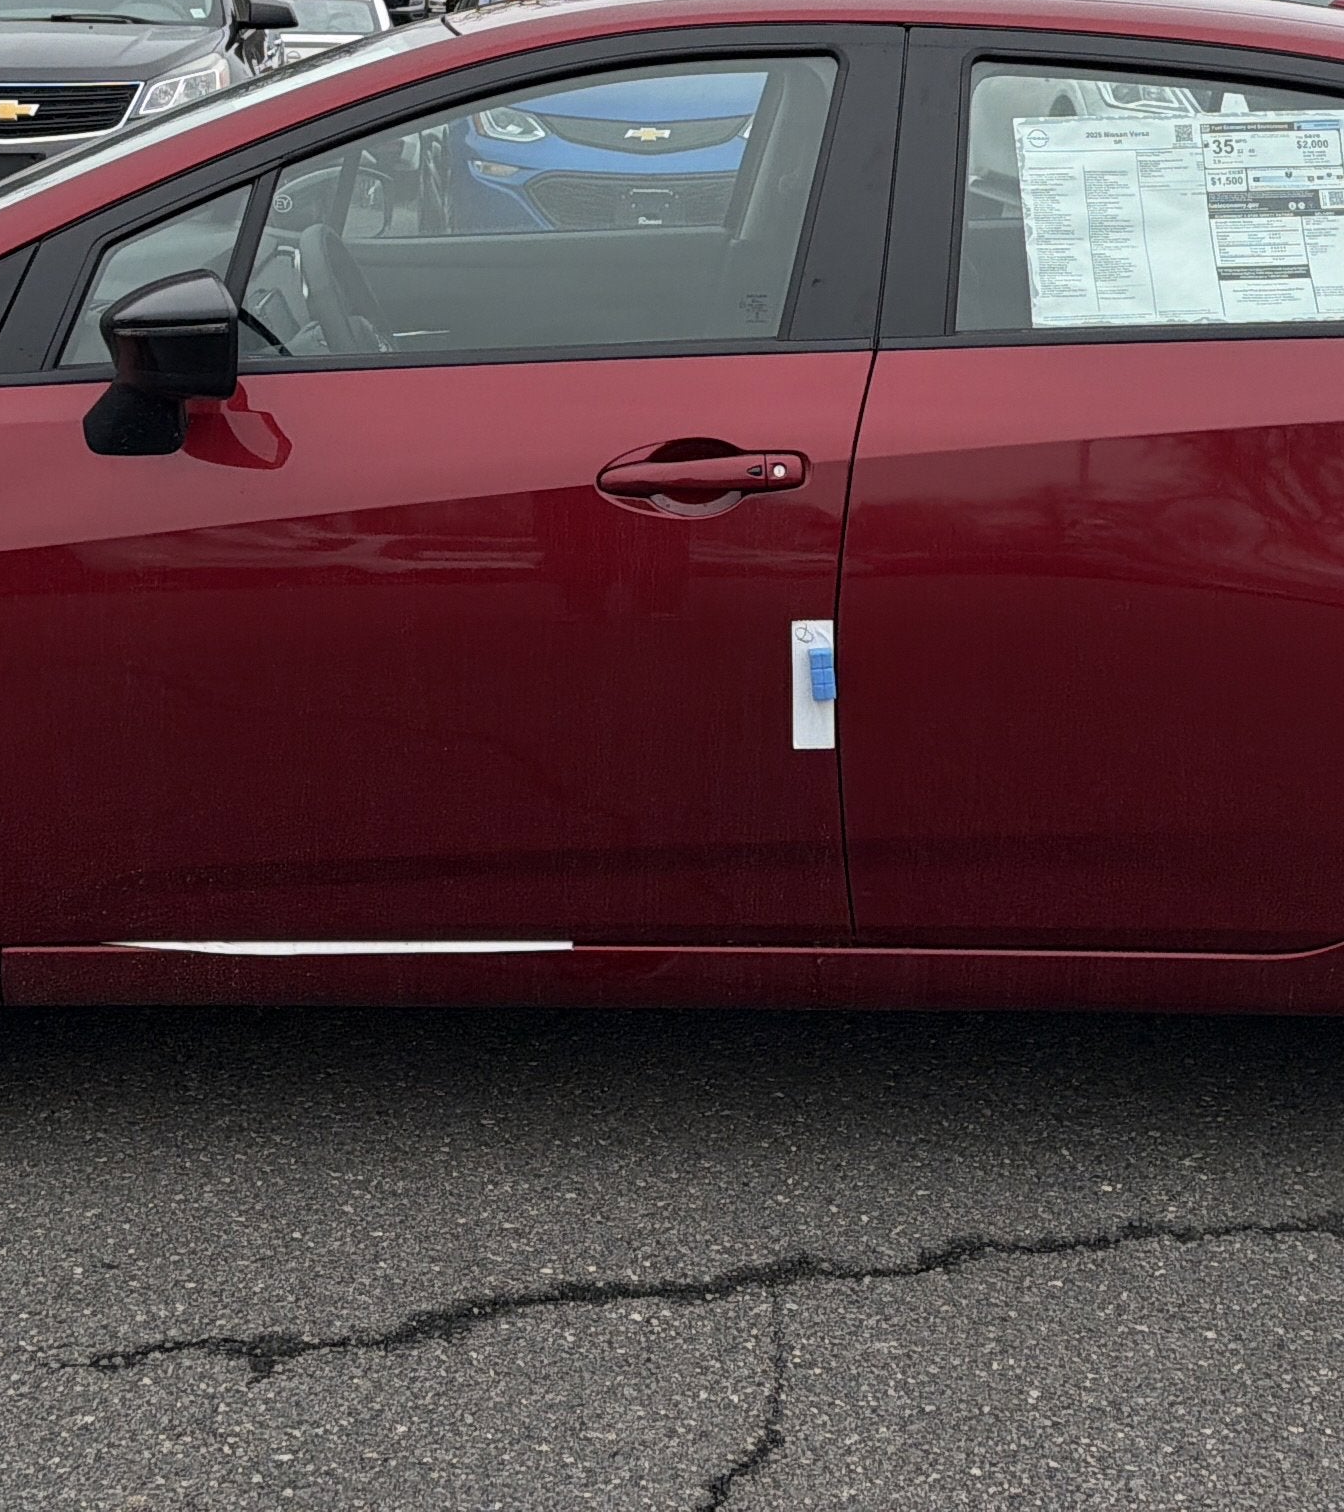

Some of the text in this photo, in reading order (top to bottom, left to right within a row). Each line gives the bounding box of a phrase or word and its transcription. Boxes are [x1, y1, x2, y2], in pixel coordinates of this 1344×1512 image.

[1212, 139, 1234, 155] 35
[1296, 139, 1329, 149] $2,000
[1210, 176, 1244, 187] $1,500
